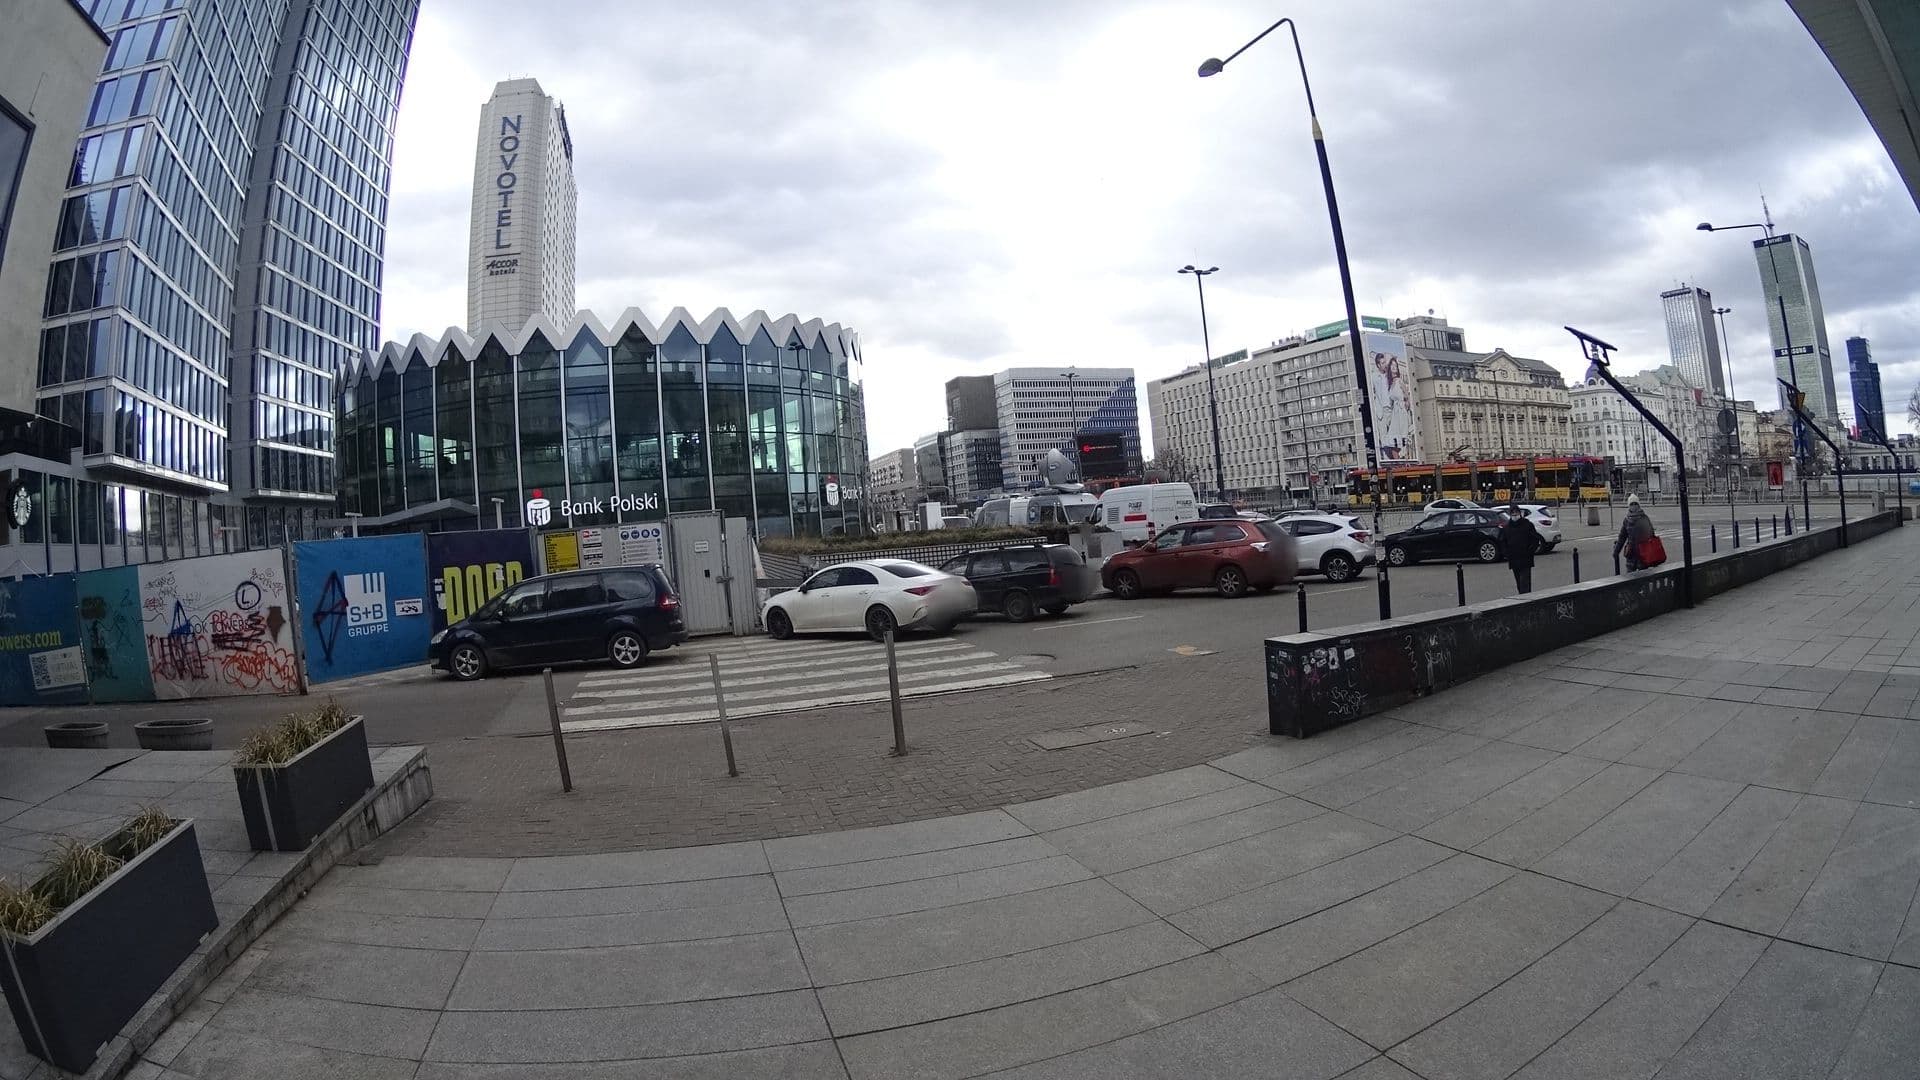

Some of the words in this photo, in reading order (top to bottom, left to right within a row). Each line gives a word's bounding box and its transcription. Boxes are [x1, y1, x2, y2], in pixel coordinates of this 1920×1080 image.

[495, 115, 522, 249] NOVOTEL
[1780, 347, 1807, 356] SASUNG
[561, 496, 604, 516] Bank
[610, 492, 658, 512] Polski
[350, 603, 384, 623] S+B
[348, 623, 390, 637] GRUPPE
